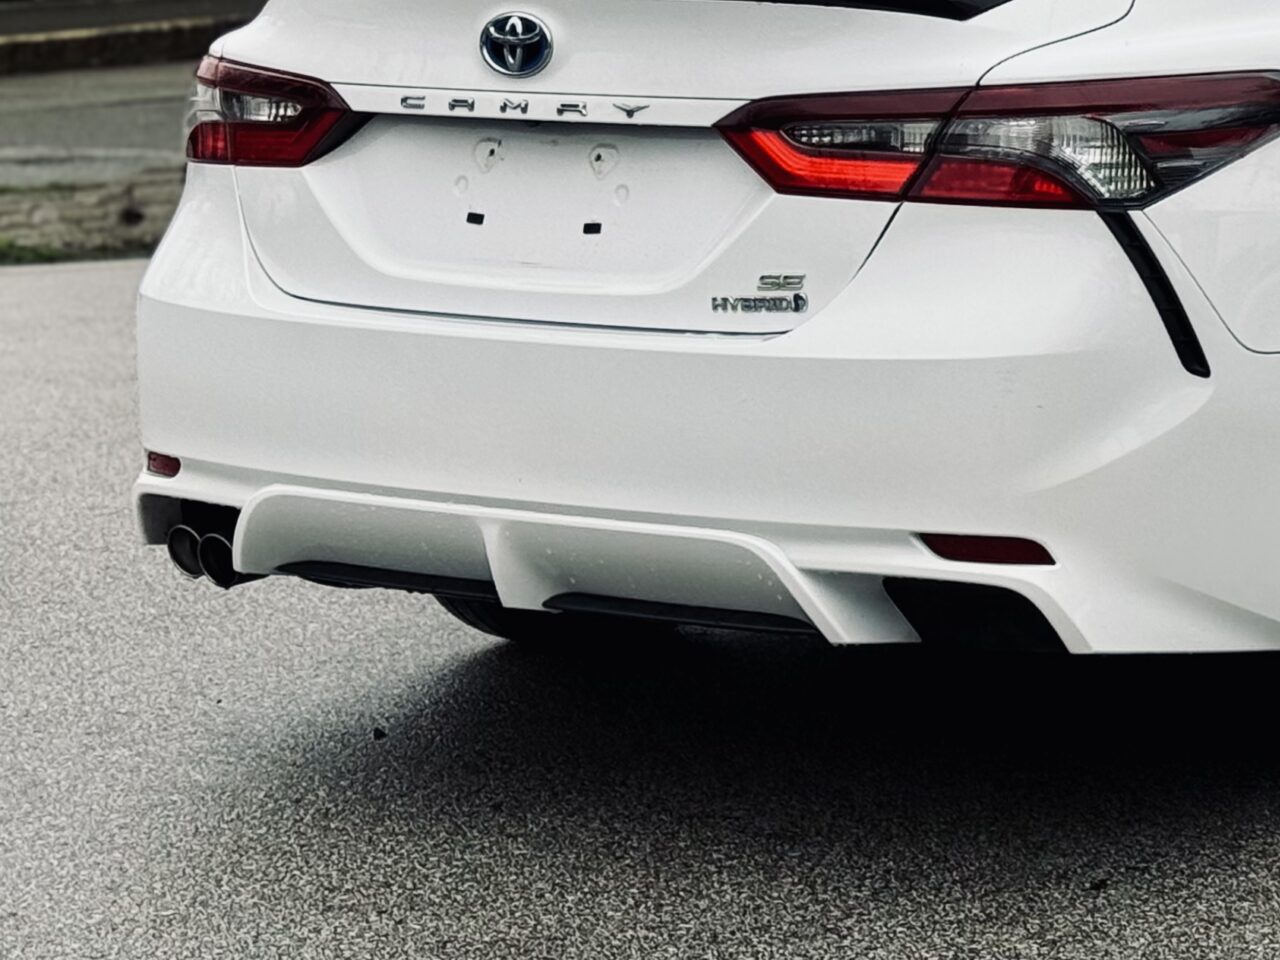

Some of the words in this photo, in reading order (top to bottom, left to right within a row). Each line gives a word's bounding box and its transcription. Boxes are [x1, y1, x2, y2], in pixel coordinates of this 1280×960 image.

[400, 95, 651, 119] CAMRY
[756, 274, 806, 291] SE
[711, 296, 790, 313] HYBRID
